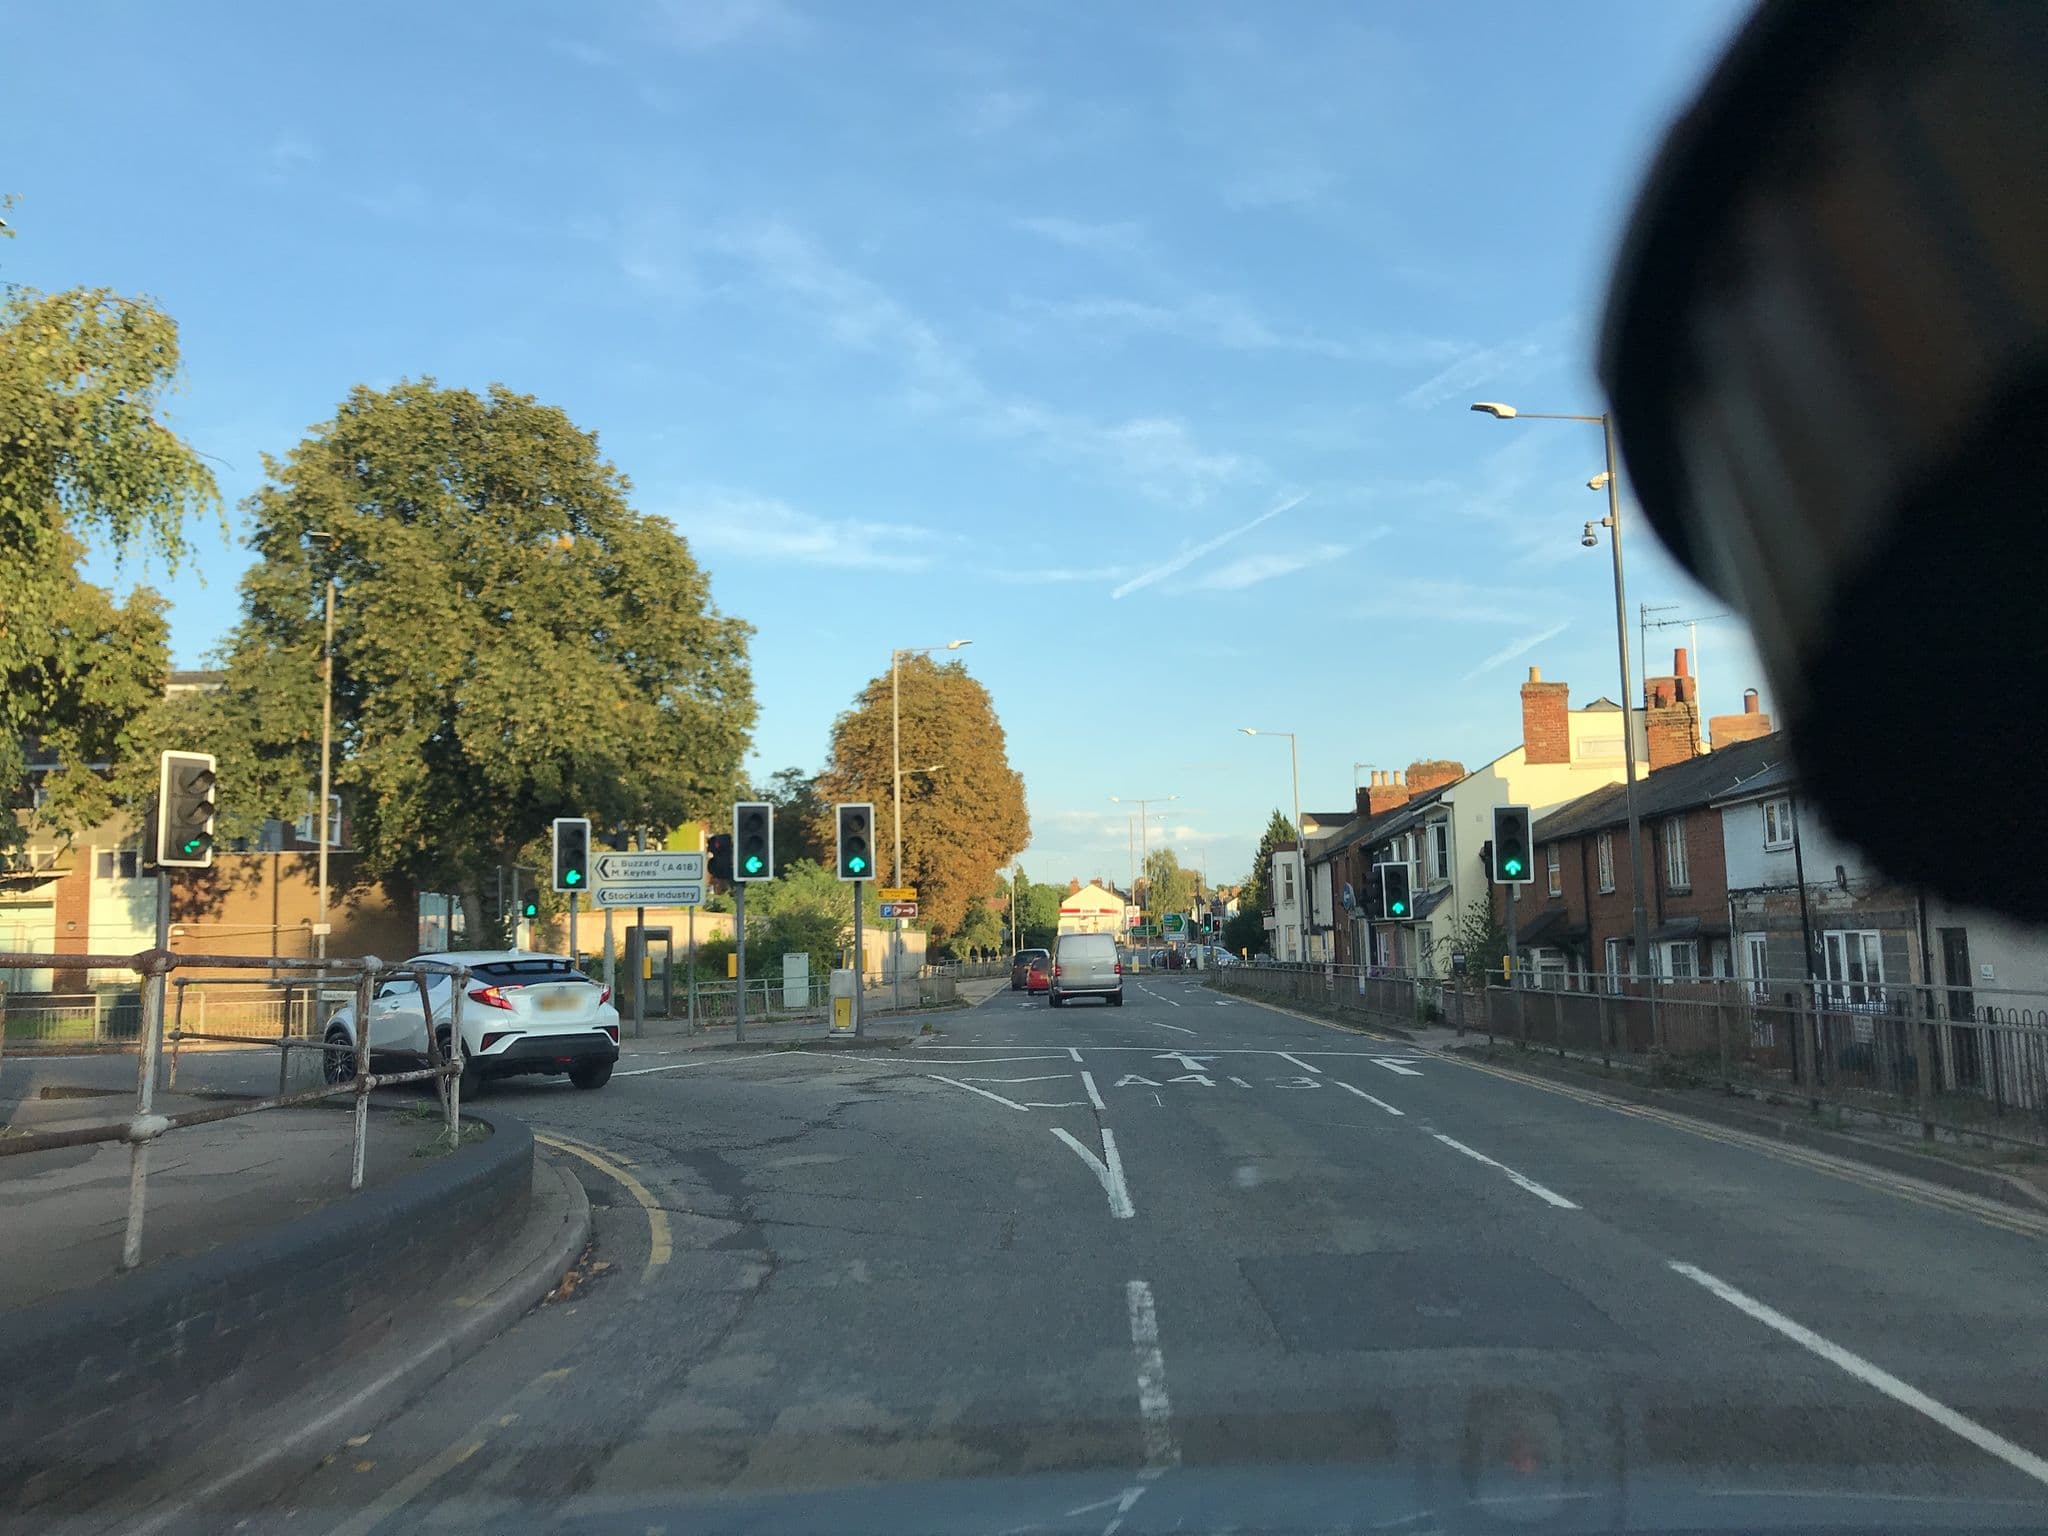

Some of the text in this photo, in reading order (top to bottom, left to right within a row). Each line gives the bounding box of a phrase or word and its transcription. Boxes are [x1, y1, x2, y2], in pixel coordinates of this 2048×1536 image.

[621, 859, 660, 868] Buzzard
[624, 869, 656, 878] Keynes
[608, 891, 696, 900] Stocklake Industry
